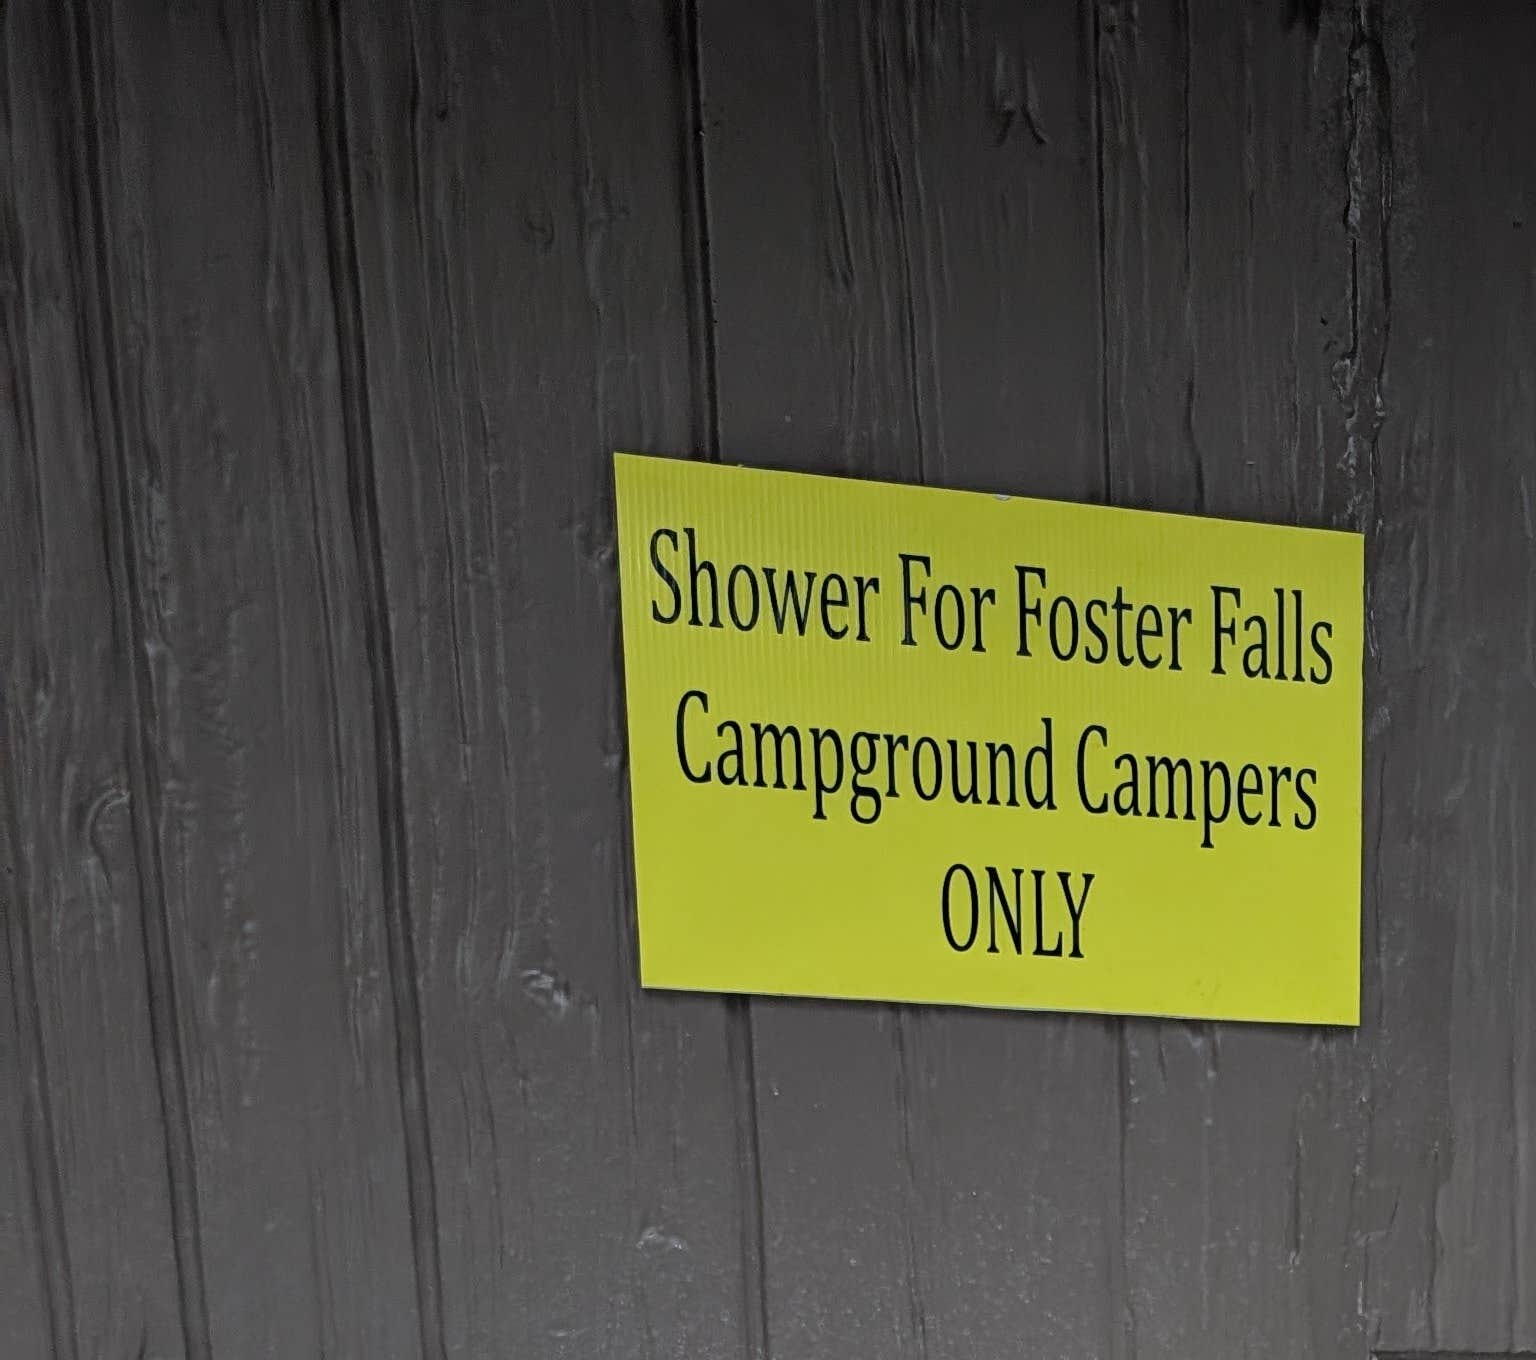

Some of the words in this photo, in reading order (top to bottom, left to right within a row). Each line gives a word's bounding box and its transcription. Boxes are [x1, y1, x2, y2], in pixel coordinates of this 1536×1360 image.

[648, 527, 880, 642] Shower
[898, 553, 997, 653] For
[1014, 564, 1193, 671] Foster
[1210, 584, 1334, 685] Falls
[674, 689, 1058, 824] Campground
[1076, 723, 1319, 849] Campers
[941, 862, 1096, 960] ONLY
